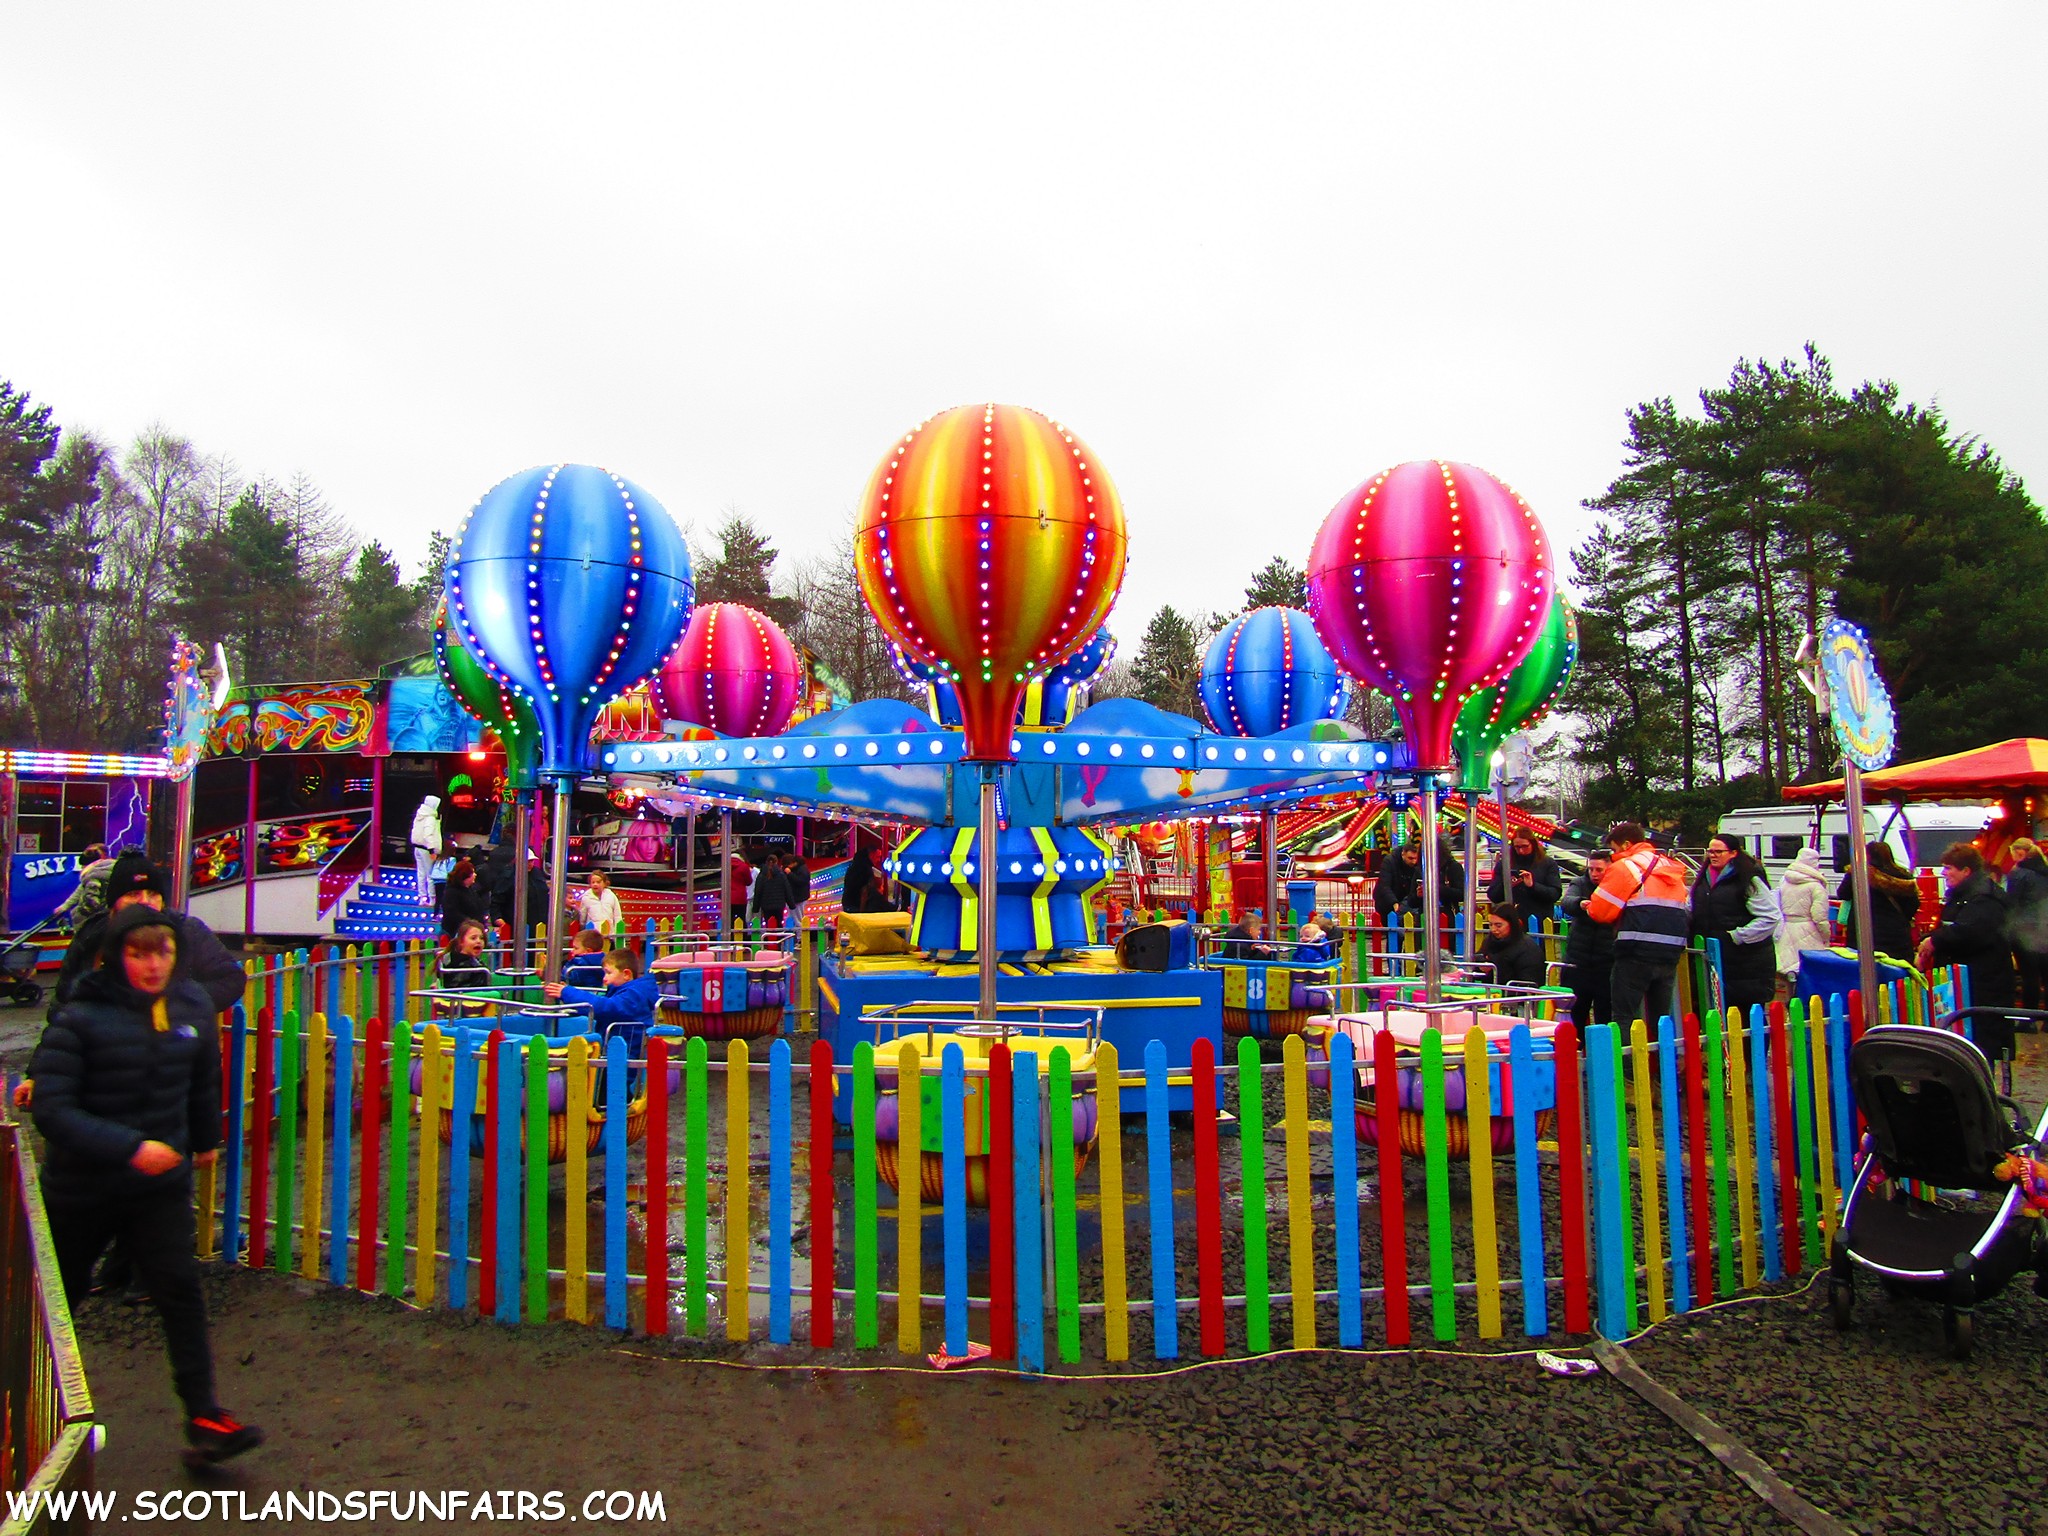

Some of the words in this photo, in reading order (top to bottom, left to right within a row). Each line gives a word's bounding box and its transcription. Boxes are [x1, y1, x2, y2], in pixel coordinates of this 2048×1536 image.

[587, 838, 629, 857] POWER
[24, 856, 67, 878] SKY
[705, 980, 721, 1001] 6
[1248, 978, 1264, 1000] 8
